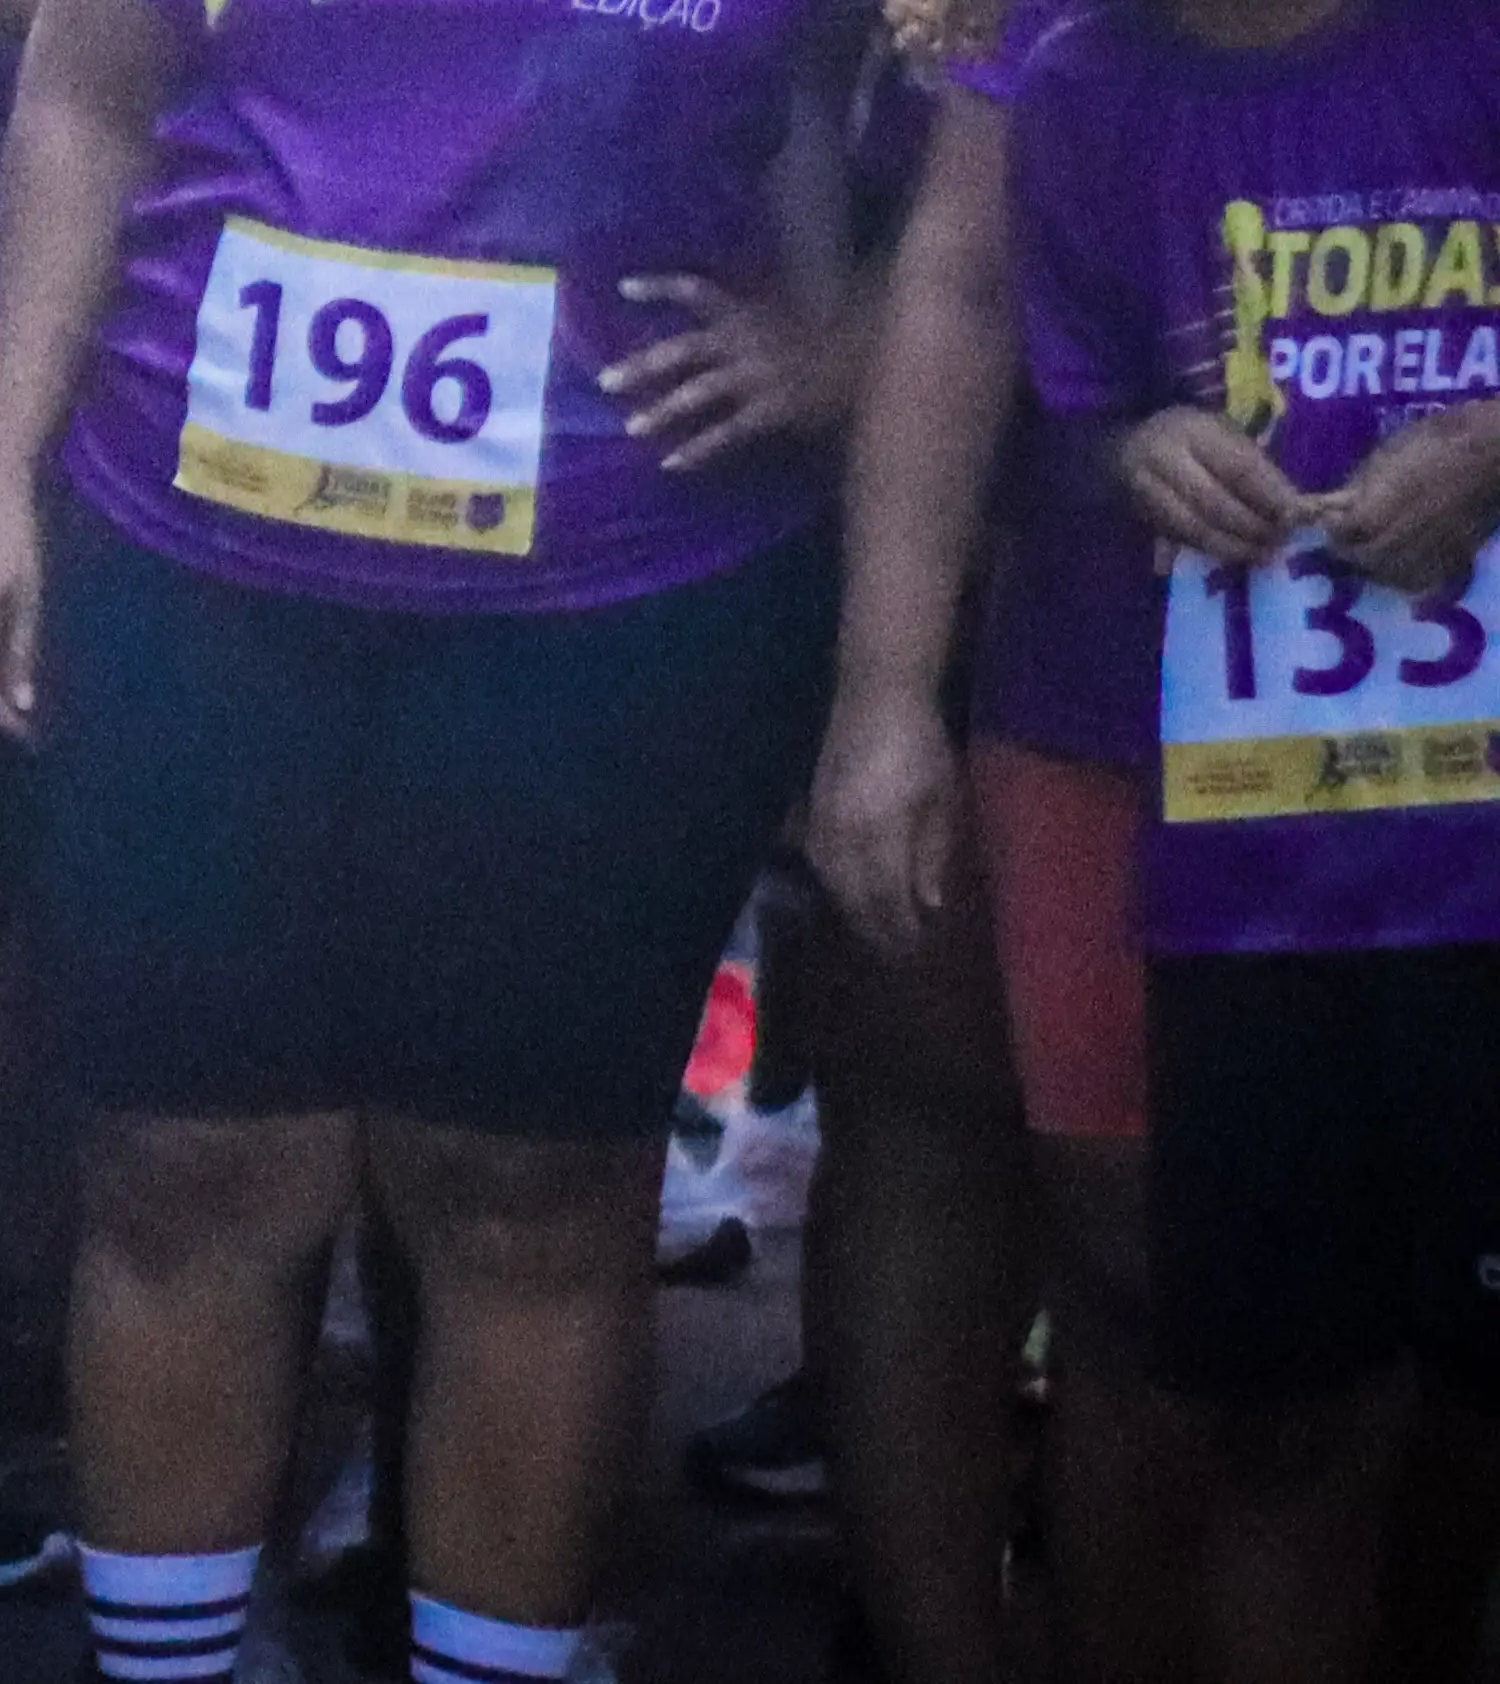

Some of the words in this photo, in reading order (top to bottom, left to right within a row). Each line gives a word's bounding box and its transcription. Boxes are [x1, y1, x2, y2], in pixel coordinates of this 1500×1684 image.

[1265, 219, 1500, 318] TODA
[237, 278, 494, 444] 196
[1269, 331, 1386, 400] POR
